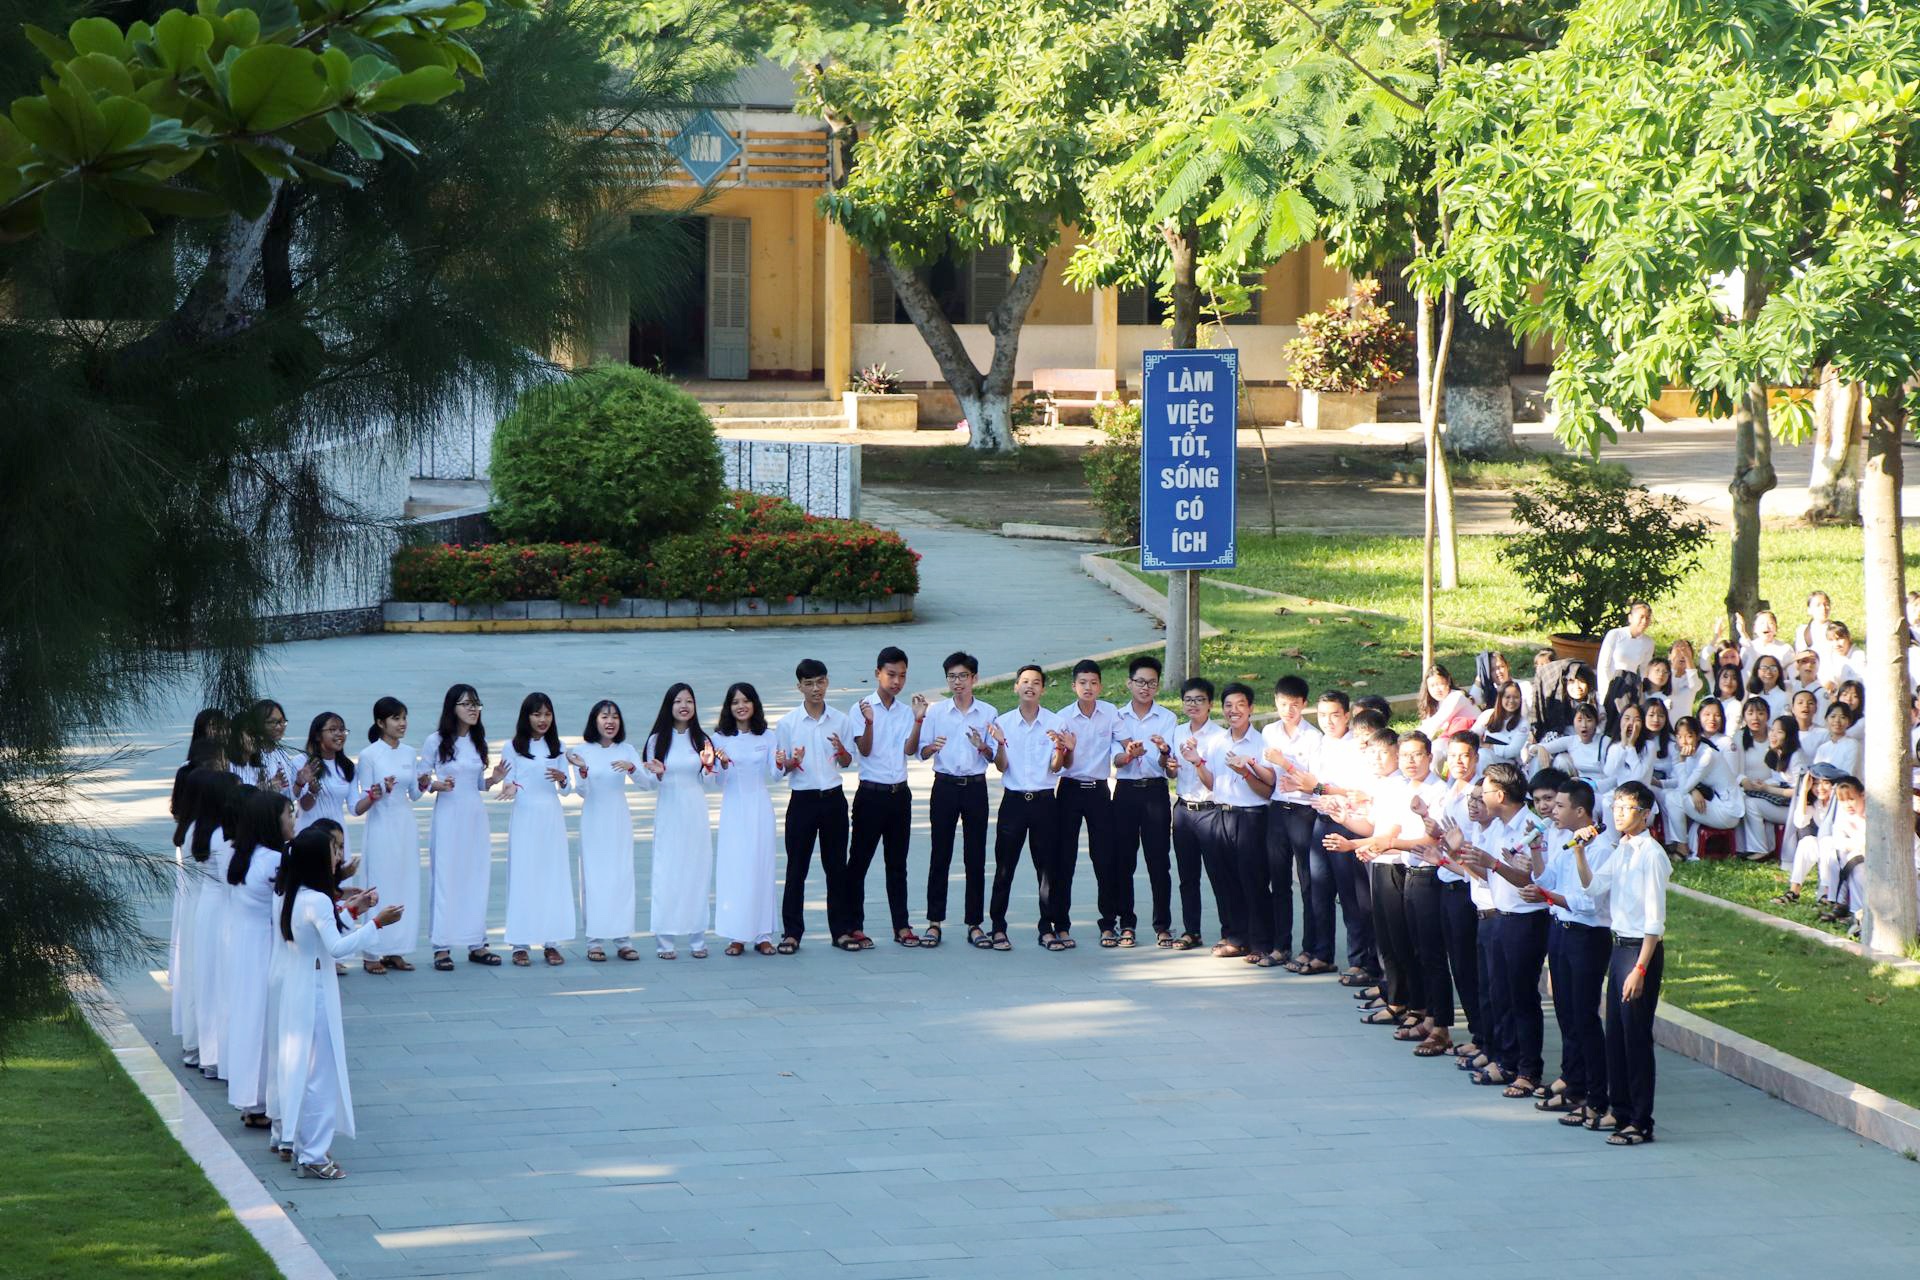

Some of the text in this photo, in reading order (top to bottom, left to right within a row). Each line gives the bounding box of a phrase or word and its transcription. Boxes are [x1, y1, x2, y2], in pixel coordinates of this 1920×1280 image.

[1168, 367, 1213, 393] LÀM
[1167, 400, 1214, 429] VIỆC
[1169, 428, 1210, 459] TỐT,
[1160, 461, 1219, 489] SỐNG
[1175, 496, 1204, 521] CÓ
[1172, 528, 1207, 553] ÍCH
